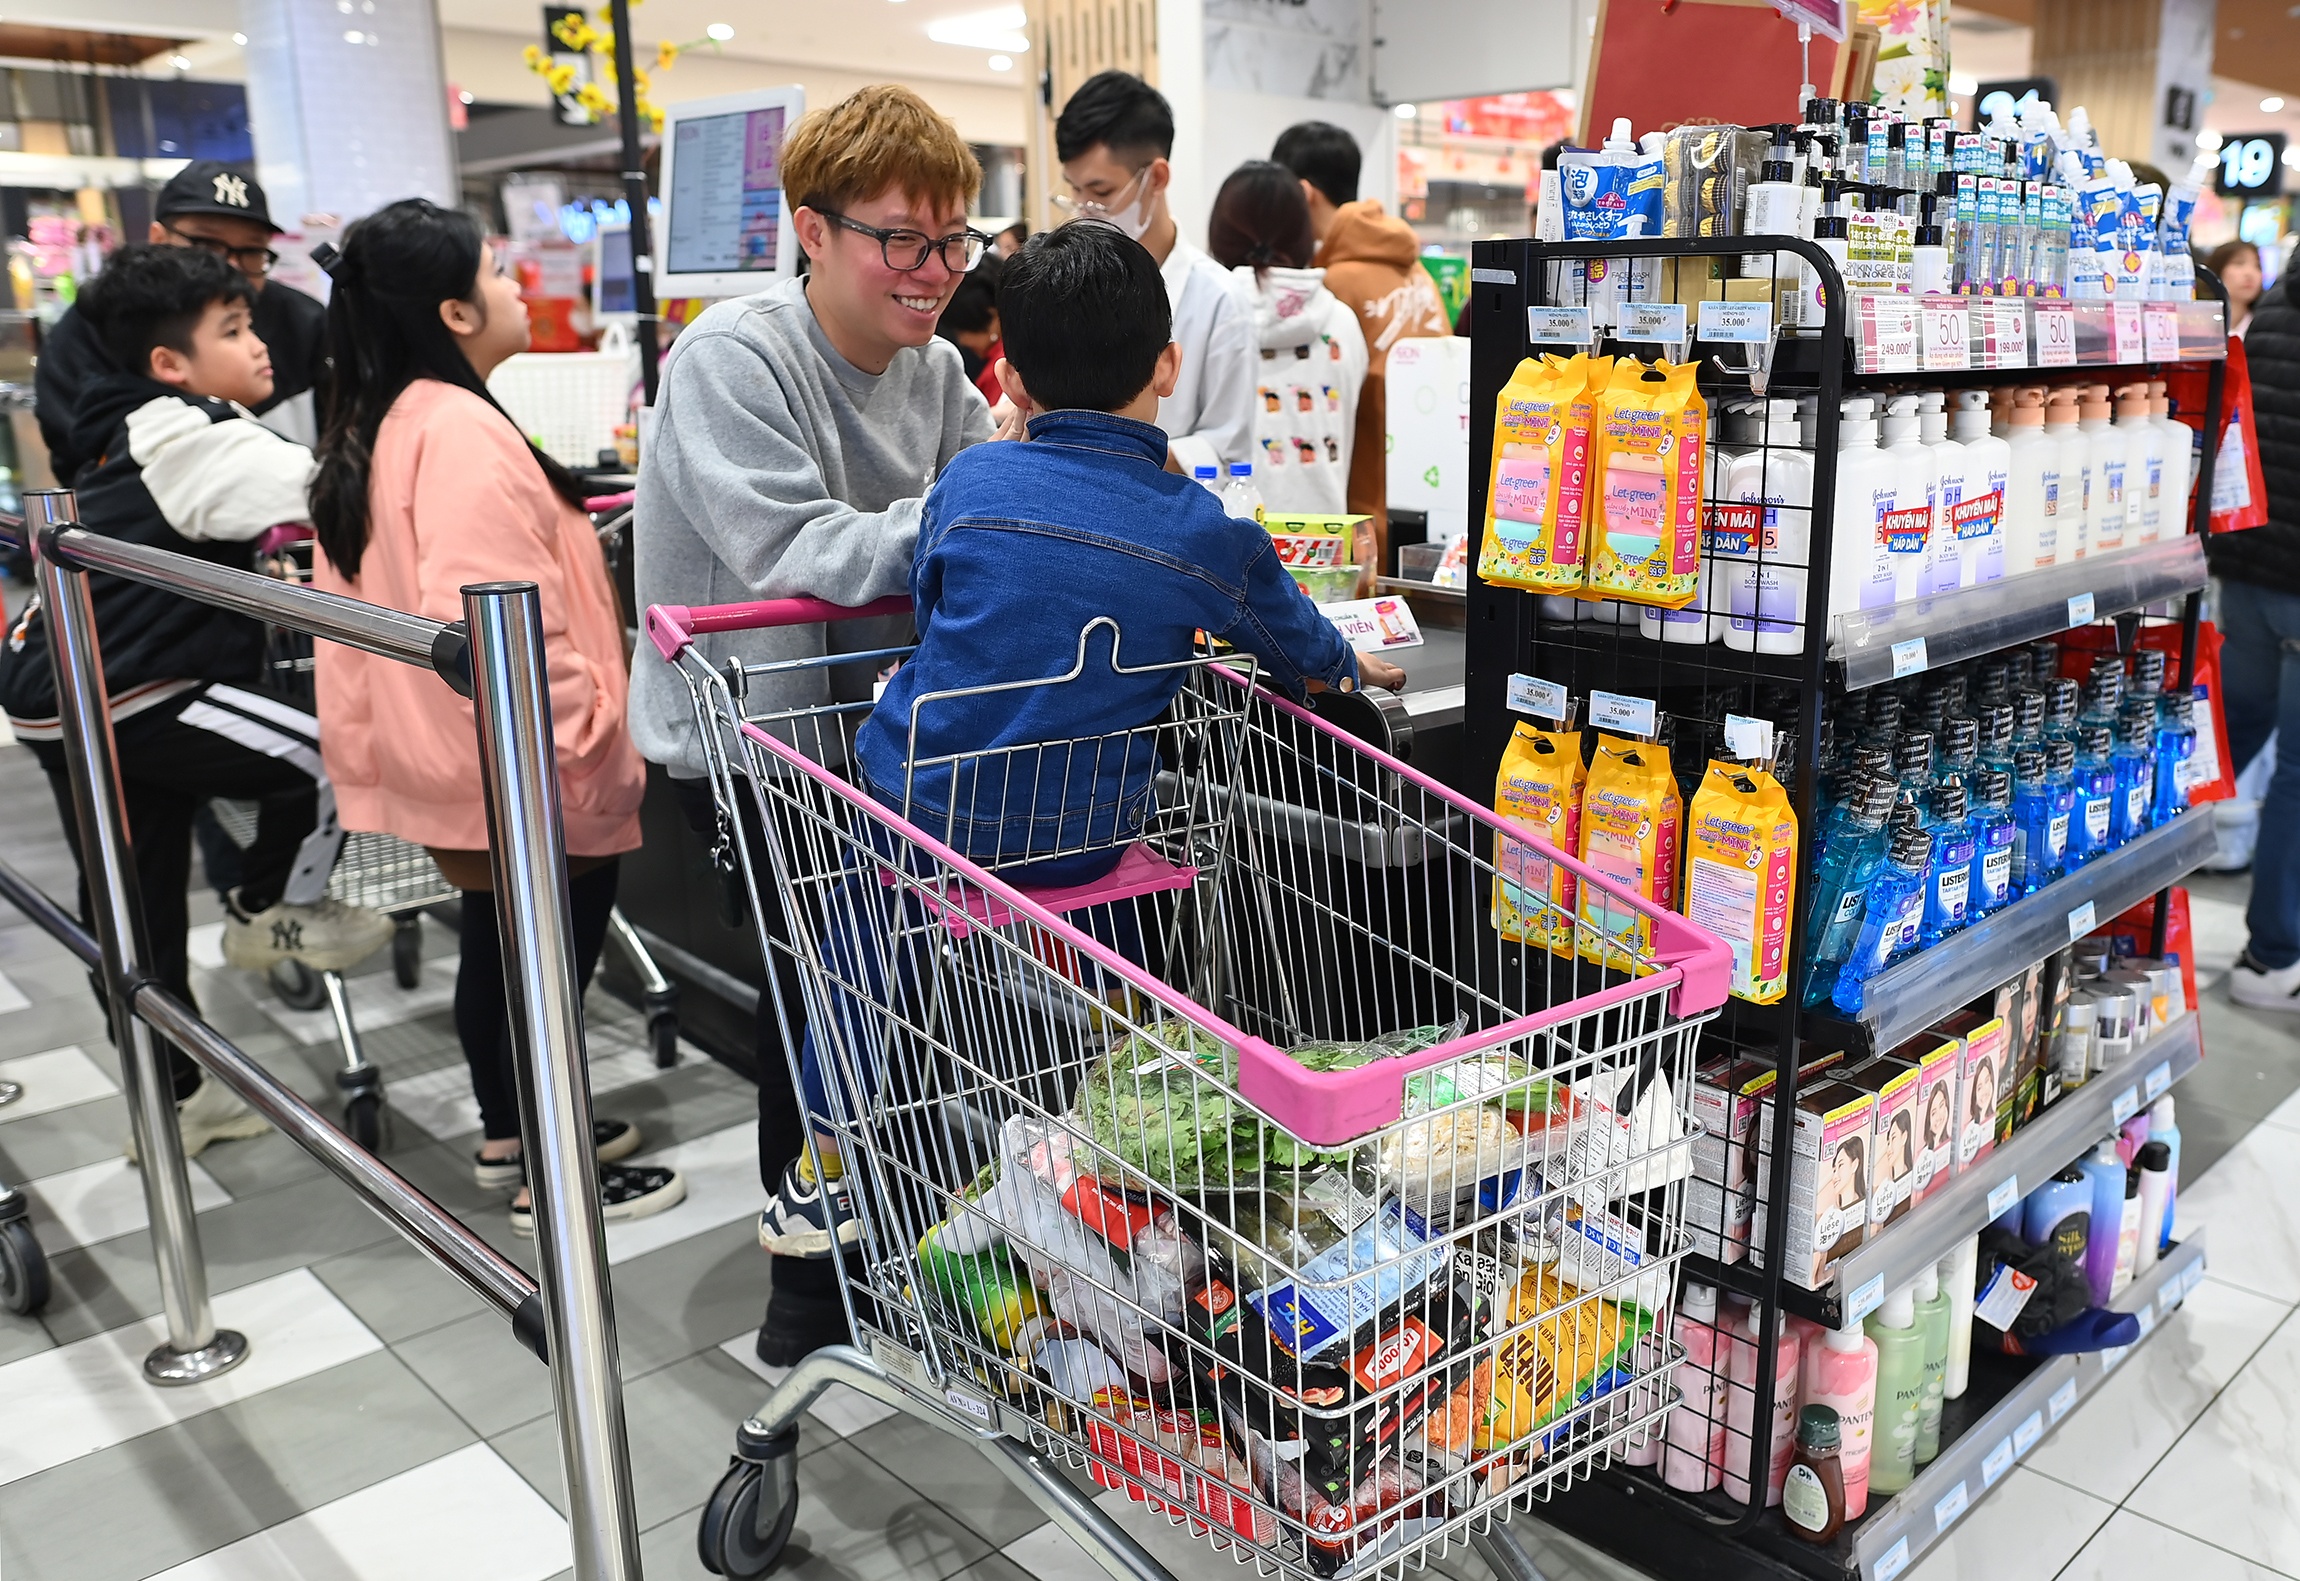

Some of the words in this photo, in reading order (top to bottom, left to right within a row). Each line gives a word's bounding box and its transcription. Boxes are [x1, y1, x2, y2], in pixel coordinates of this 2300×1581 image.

[2219, 138, 2274, 188] 19
[1571, 169, 1589, 189] 泡
[1549, 319, 1570, 327] 35.000
[1638, 316, 1661, 325] 35.000
[1721, 318, 1745, 327] 35.000
[1939, 313, 1960, 345] 50
[2050, 315, 2067, 343] 50
[1510, 398, 1551, 414] Let-green
[1524, 416, 1551, 429] MINI
[1614, 406, 1660, 424] Let-green
[1551, 428, 1556, 436] 6
[1631, 425, 1661, 438] MINI
[1500, 473, 1539, 490] Let-green
[1513, 494, 1539, 507] MINI
[1612, 485, 1656, 502] Let-green
[1945, 488, 1961, 506] pH
[1630, 506, 1657, 519] MINI
[1730, 509, 1756, 529] MÃI
[1954, 502, 1982, 521] KHUYẾN
[1885, 509, 1915, 530] KHUYẾN
[1751, 570, 1756, 578] 2
[1345, 620, 1375, 635] VIÊN
[1526, 687, 1546, 700] 35.000
[1609, 706, 1631, 717] 35.000
[1509, 774, 1550, 794] Let-green
[1524, 794, 1551, 808] MINI
[1597, 788, 1641, 808] Let-green
[1552, 808, 1557, 816] 6
[1612, 807, 1640, 825] MINI
[1641, 823, 1647, 831] 6
[1704, 811, 1750, 836] Let-green
[1610, 832, 1636, 846] MINI
[1721, 834, 1751, 852] MINI
[1752, 852, 1758, 860] 6
[1916, 1161, 1932, 1174] Liese
[1876, 1192, 1893, 1206] Liese
[1820, 1219, 1840, 1234] Liese
[1819, 1230, 1839, 1246] 泡カラー
